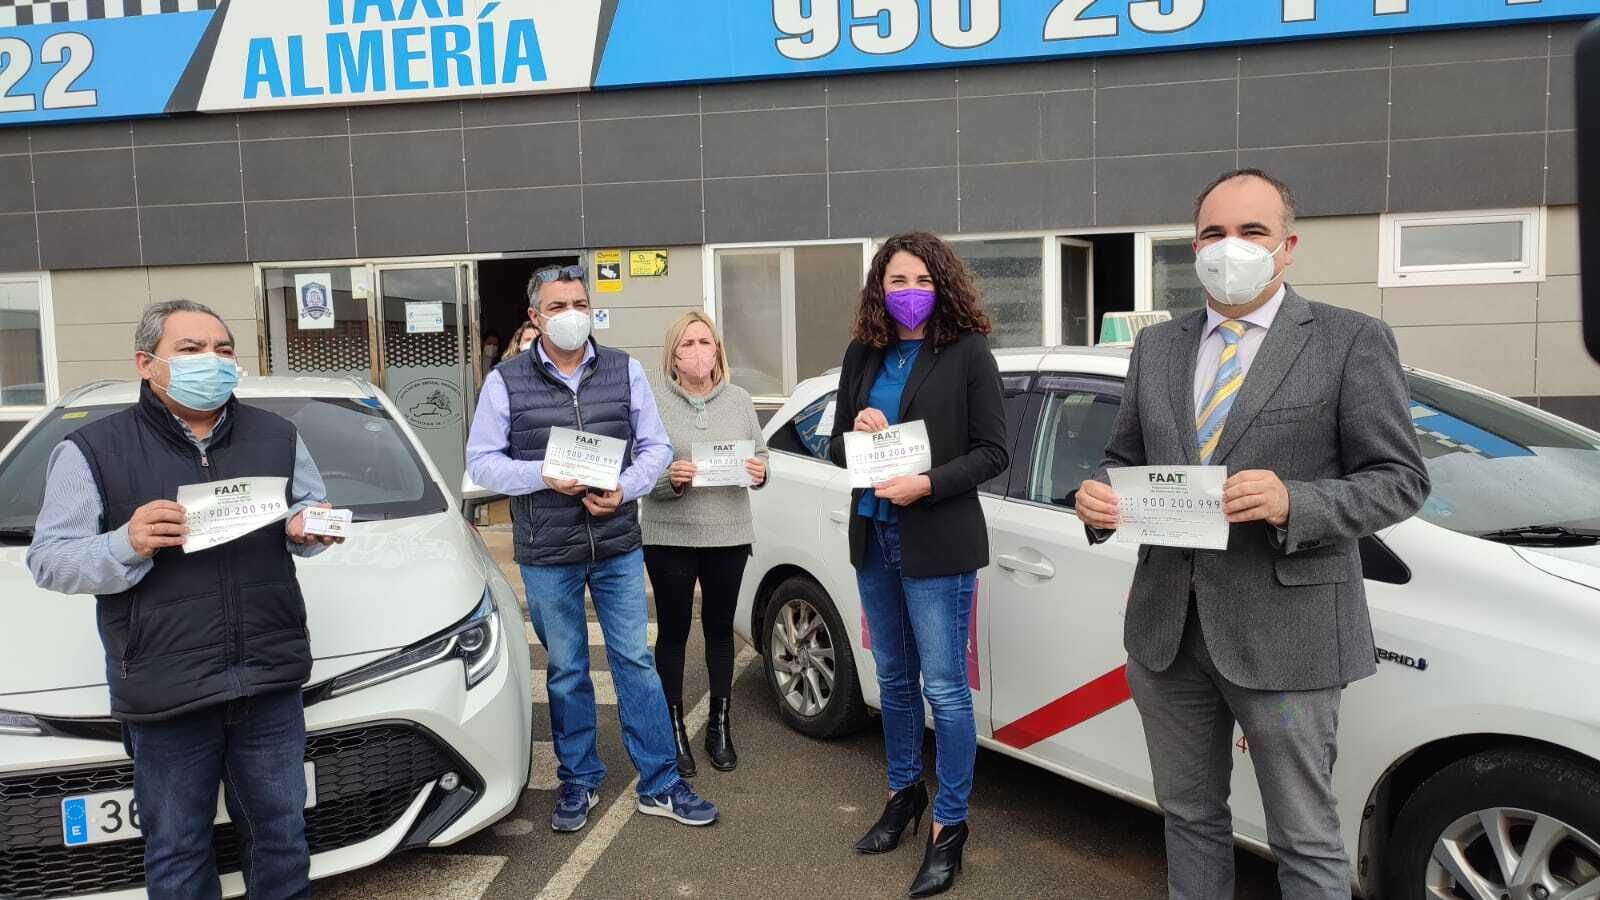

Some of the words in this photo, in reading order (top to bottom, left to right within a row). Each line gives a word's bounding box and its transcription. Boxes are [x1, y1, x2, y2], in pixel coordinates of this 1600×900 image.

[243, 1, 547, 99] ALMERÍA
[0, 32, 98, 113] 22
[575, 435, 601, 446] FAAT
[872, 430, 900, 441] FAAT
[1148, 472, 1185, 483] FAAT
[214, 483, 249, 495] FAAT
[1142, 497, 1165, 508] 900
[1171, 498, 1193, 509] 200
[1198, 499, 1220, 510] 999
[208, 507, 230, 518] 900
[234, 504, 256, 515] 200
[260, 502, 281, 512] 999
[1376, 647, 1415, 668] BRID
[71, 825, 82, 836] E
